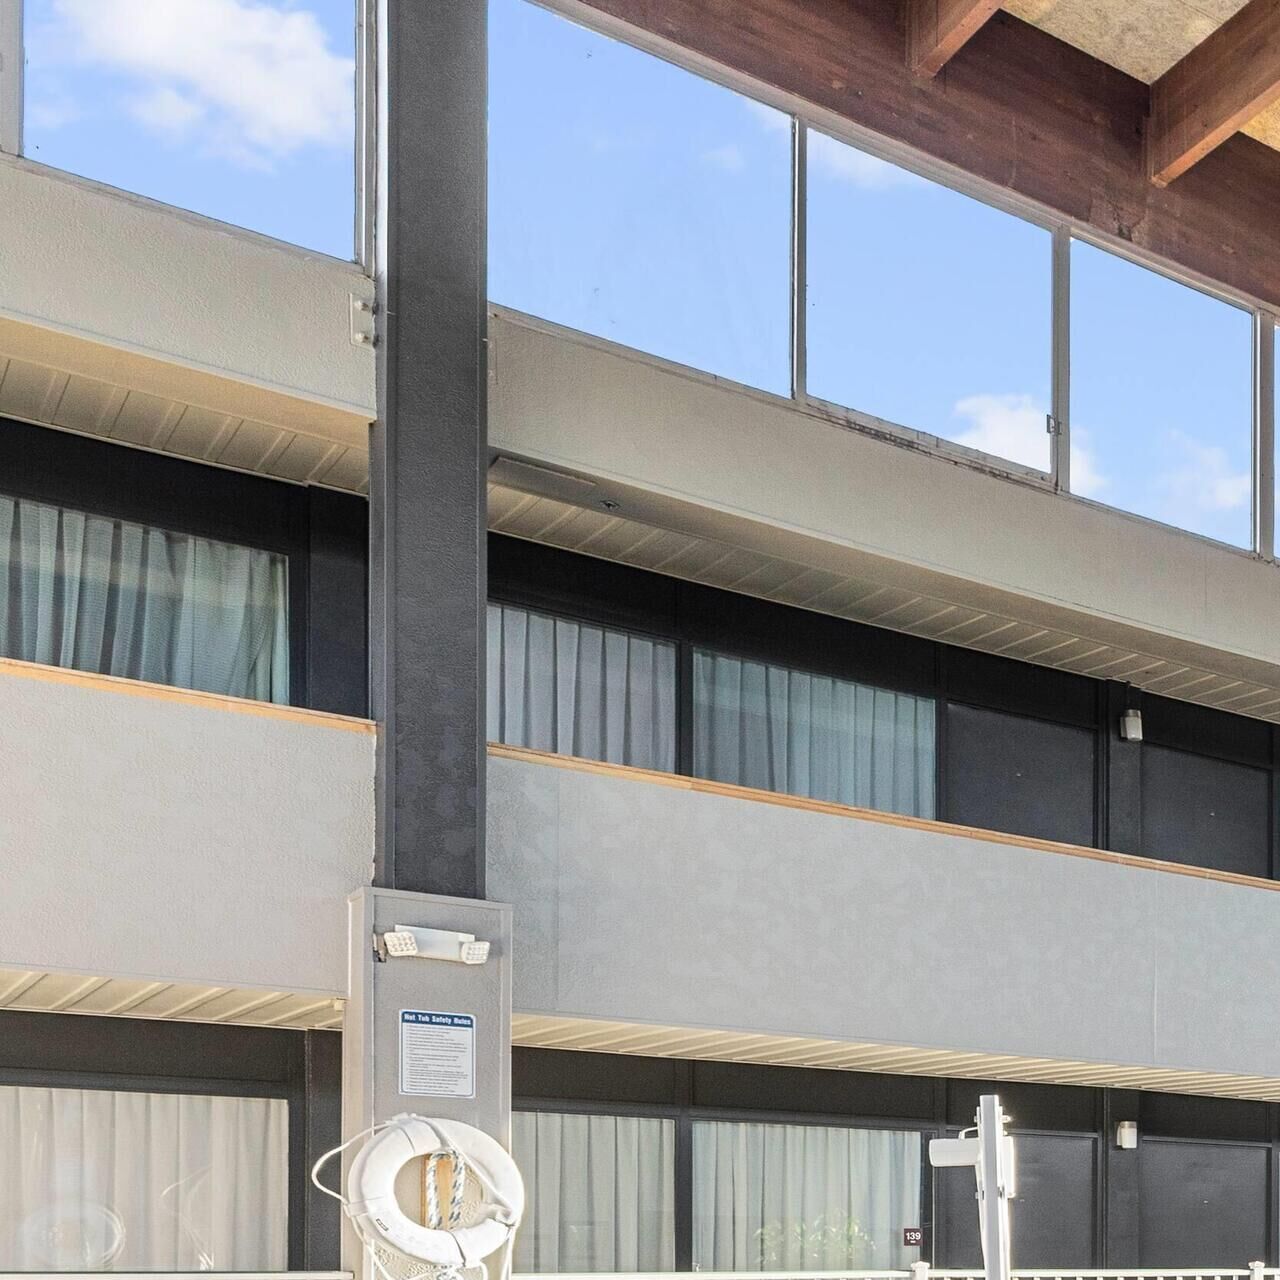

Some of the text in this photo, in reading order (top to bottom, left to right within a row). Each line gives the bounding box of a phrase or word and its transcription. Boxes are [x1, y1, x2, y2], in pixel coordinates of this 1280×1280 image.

[404, 1013, 471, 1025] Hot Tub Safety Rules
[905, 1232, 921, 1240] 139
